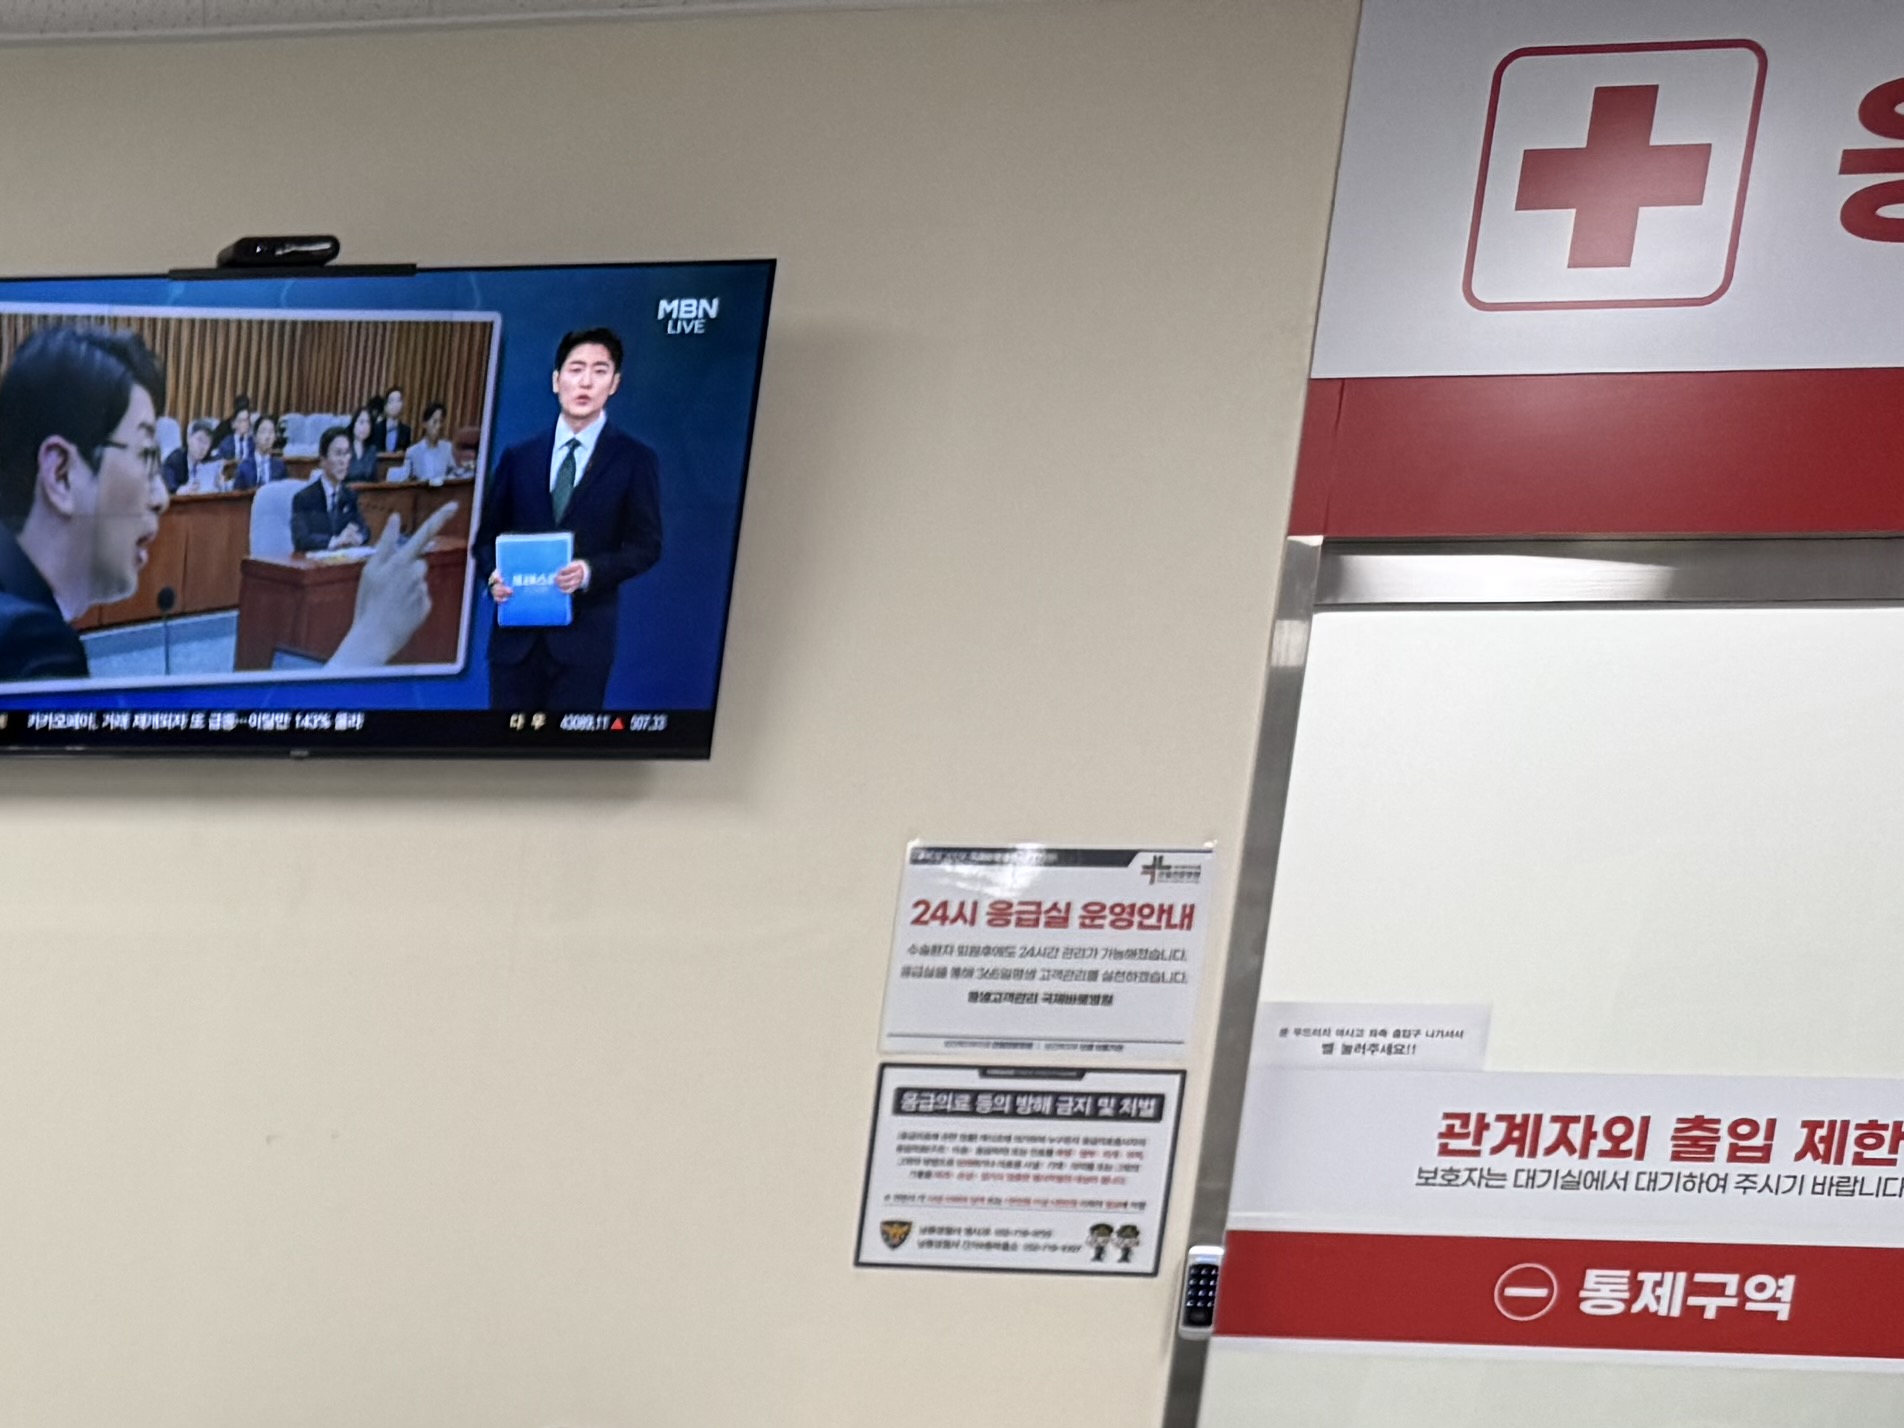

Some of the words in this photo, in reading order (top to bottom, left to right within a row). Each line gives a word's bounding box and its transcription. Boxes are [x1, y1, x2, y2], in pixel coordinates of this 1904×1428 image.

[656, 297, 719, 320] MBN
[667, 319, 706, 335] LIVE
[911, 899, 978, 927] 24시
[986, 900, 1072, 929] 응급실
[1078, 901, 1195, 932] 운영안내
[900, 1091, 970, 1113] 응급의료
[975, 1093, 1011, 1114] 등의
[1016, 1094, 1052, 1115] 방해
[1055, 1095, 1092, 1116] 금지
[1097, 1097, 1116, 1117] 및
[1119, 1097, 1156, 1118] 처벌
[1436, 1110, 1652, 1163] 관계자외
[1669, 1114, 1778, 1165] 출입
[1794, 1117, 1904, 1168] 제한
[1415, 1164, 1509, 1190] 보호자는
[1513, 1167, 1630, 1193] 대기실에서
[1634, 1170, 1729, 1195] 대기하여
[1733, 1172, 1806, 1197] 주시기
[1578, 1267, 1796, 1322] 통제구역
